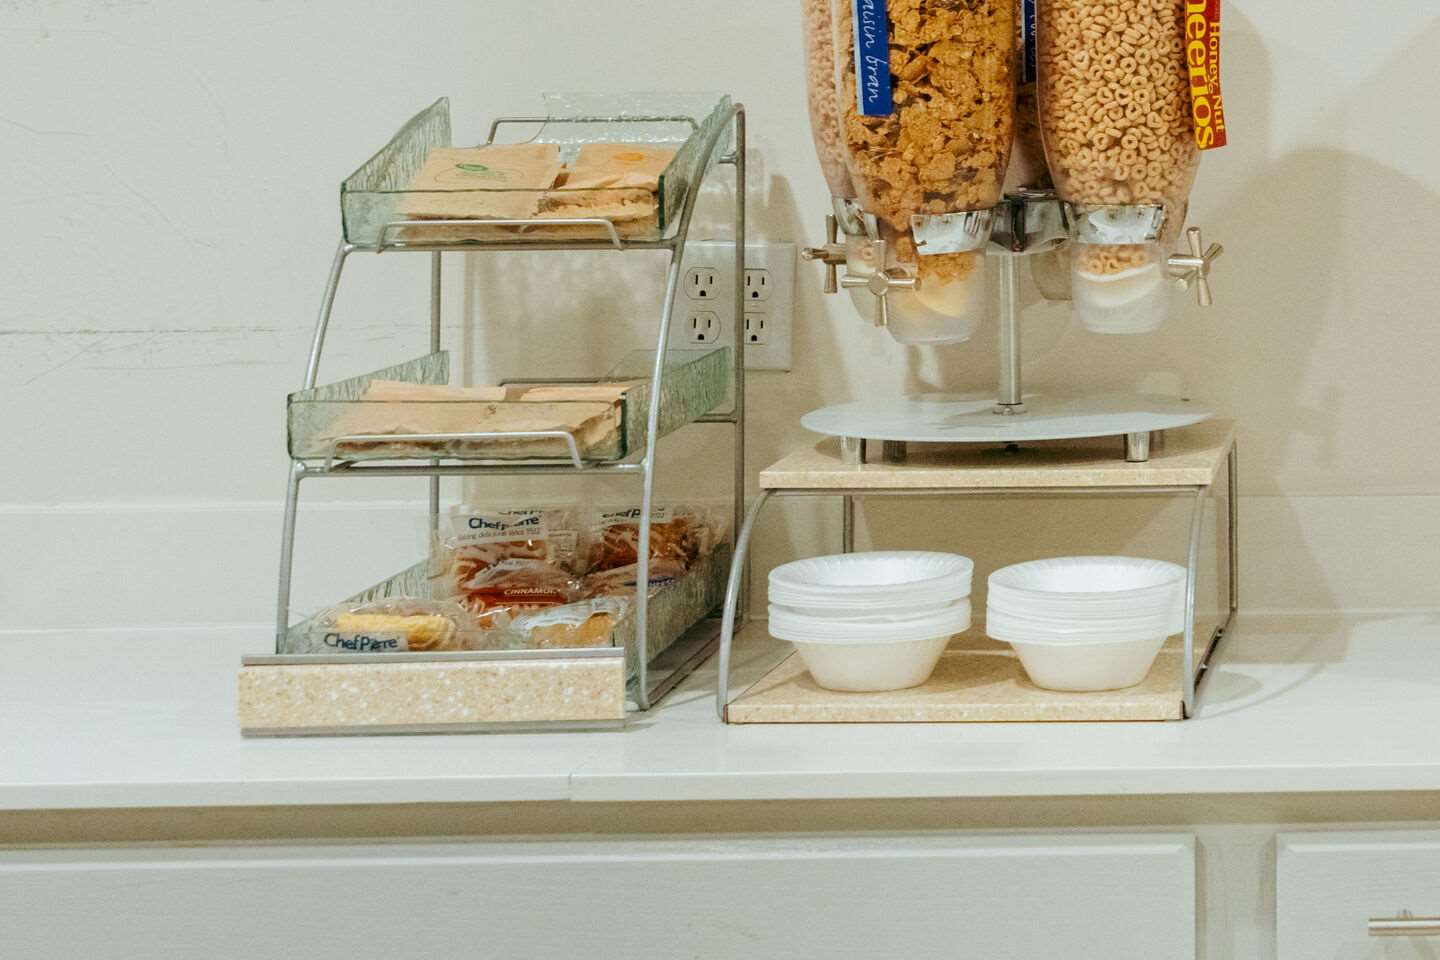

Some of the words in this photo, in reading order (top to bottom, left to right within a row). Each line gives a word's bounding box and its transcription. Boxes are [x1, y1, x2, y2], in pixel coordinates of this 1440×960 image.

[865, 54, 888, 104] bran
[1207, 21, 1221, 87] Honey
[1212, 95, 1225, 133] Nut
